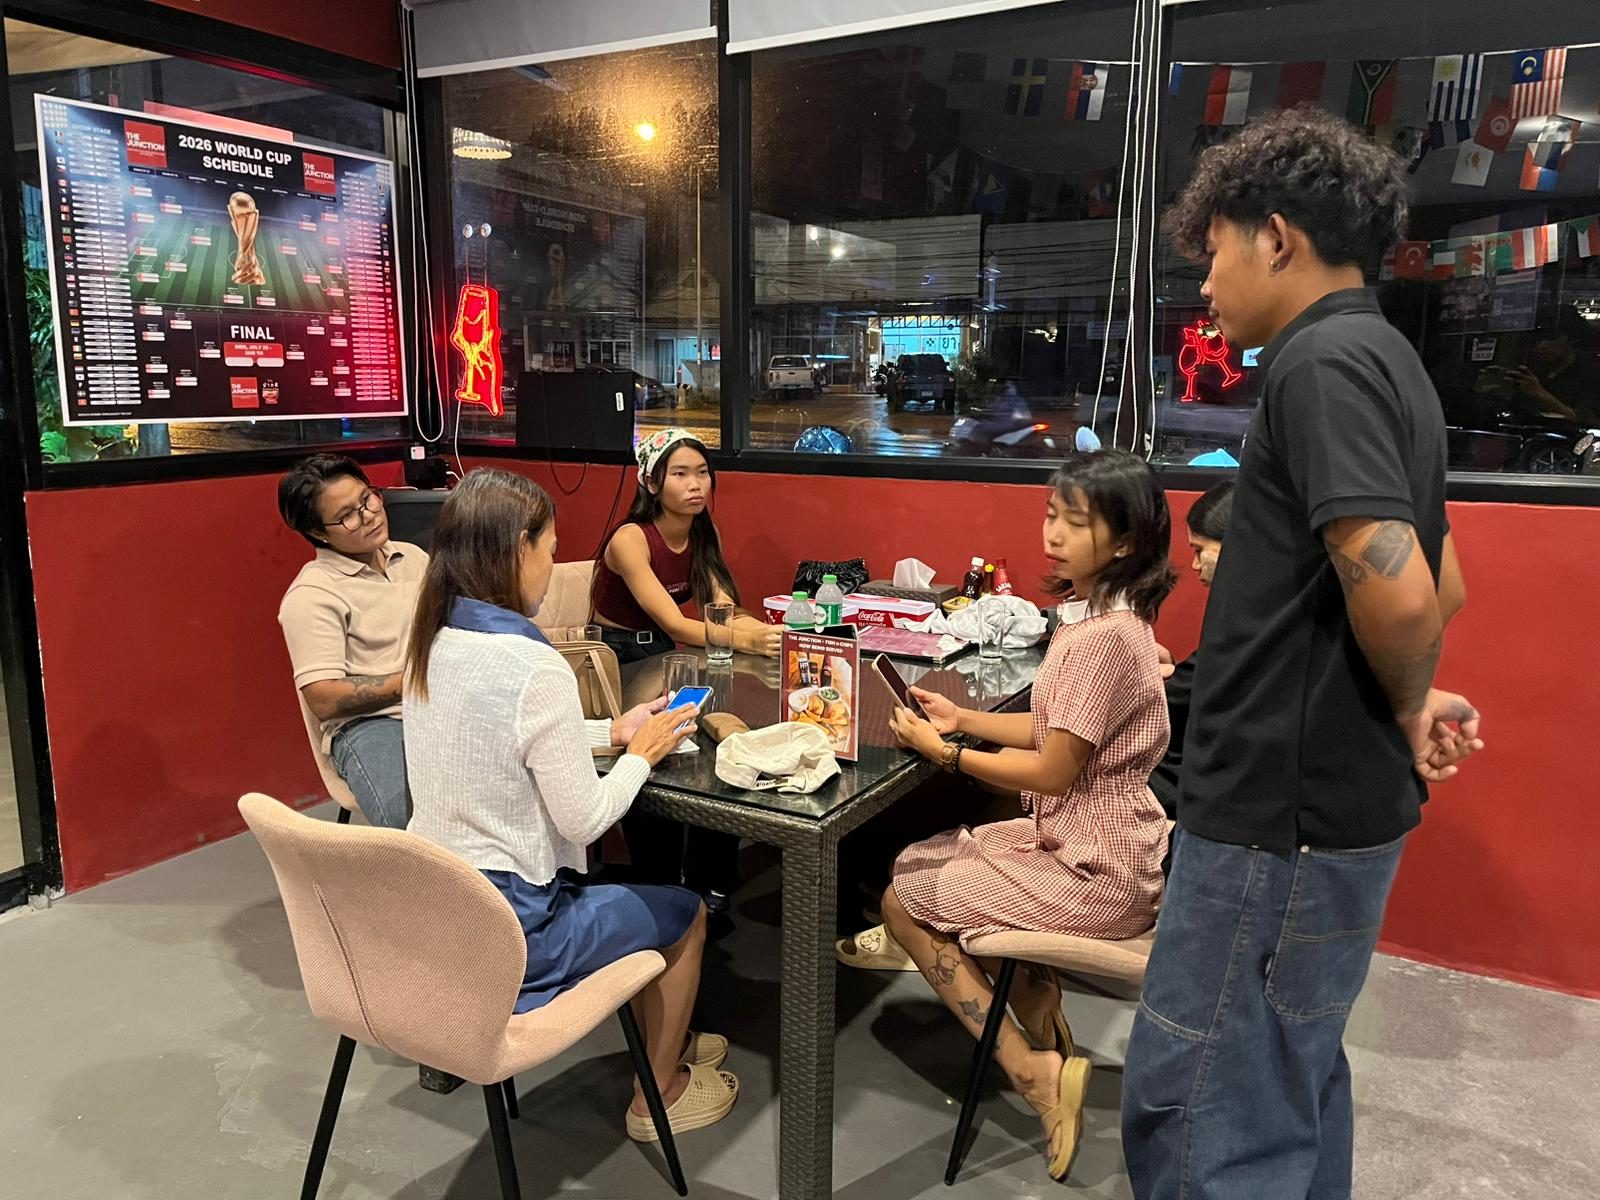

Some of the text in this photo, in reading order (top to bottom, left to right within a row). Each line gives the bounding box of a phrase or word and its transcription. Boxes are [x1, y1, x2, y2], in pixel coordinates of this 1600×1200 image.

[125, 132, 140, 141] THE
[126, 140, 165, 152] JUNCTION
[178, 135, 292, 165] 2026 WORLD CUP
[203, 155, 274, 179] SCHEDULE
[303, 162, 315, 171] THE
[304, 170, 335, 181] JUNCTION
[230, 325, 275, 340] FINAL
[798, 636, 821, 644] JUNCTION
